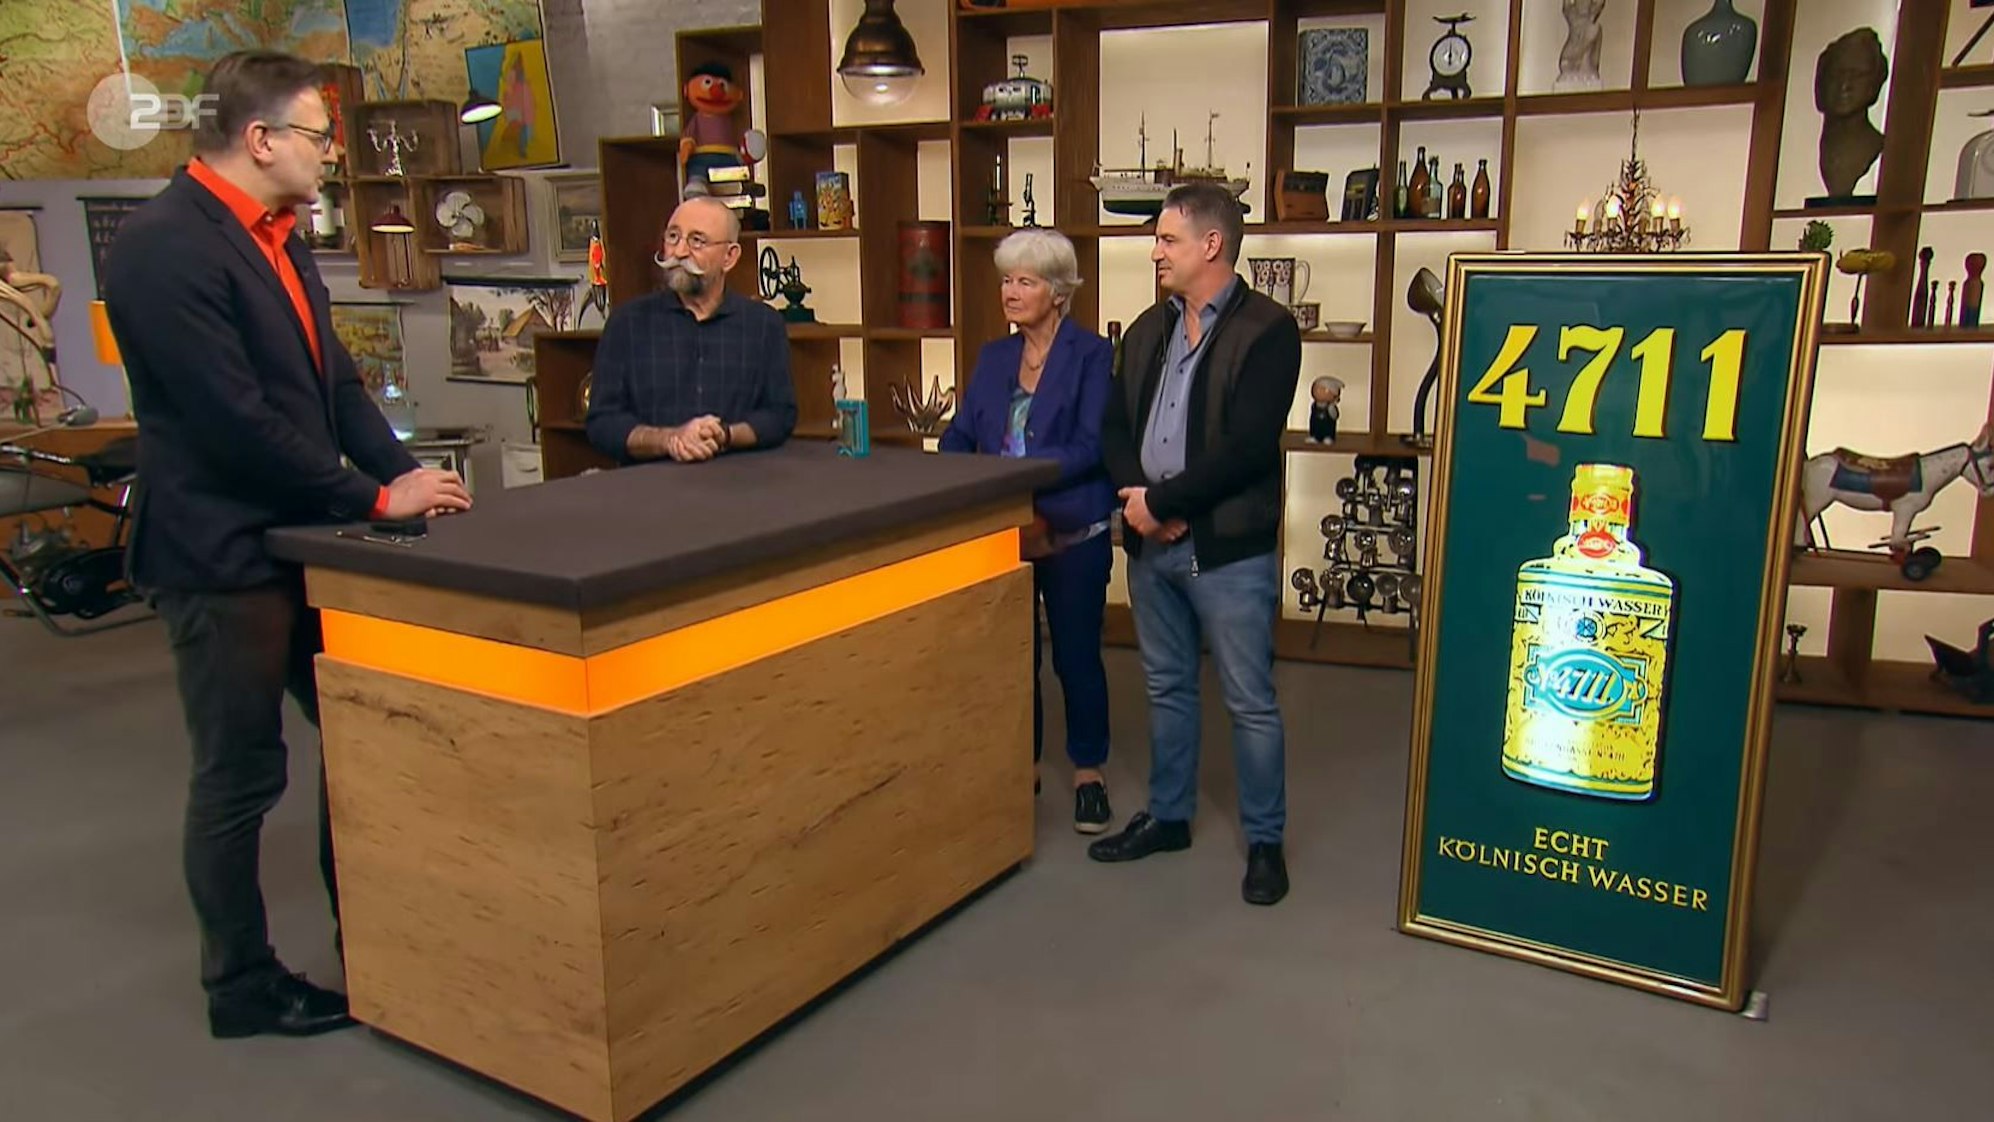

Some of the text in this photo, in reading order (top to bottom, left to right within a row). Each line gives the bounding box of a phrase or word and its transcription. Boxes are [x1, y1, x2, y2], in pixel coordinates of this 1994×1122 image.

[1467, 324, 1747, 442] 4711
[1599, 596, 1662, 616] WASSER
[1533, 827, 1609, 861] ECHT
[1438, 836, 1708, 911] KÖLNISCH WASSER
